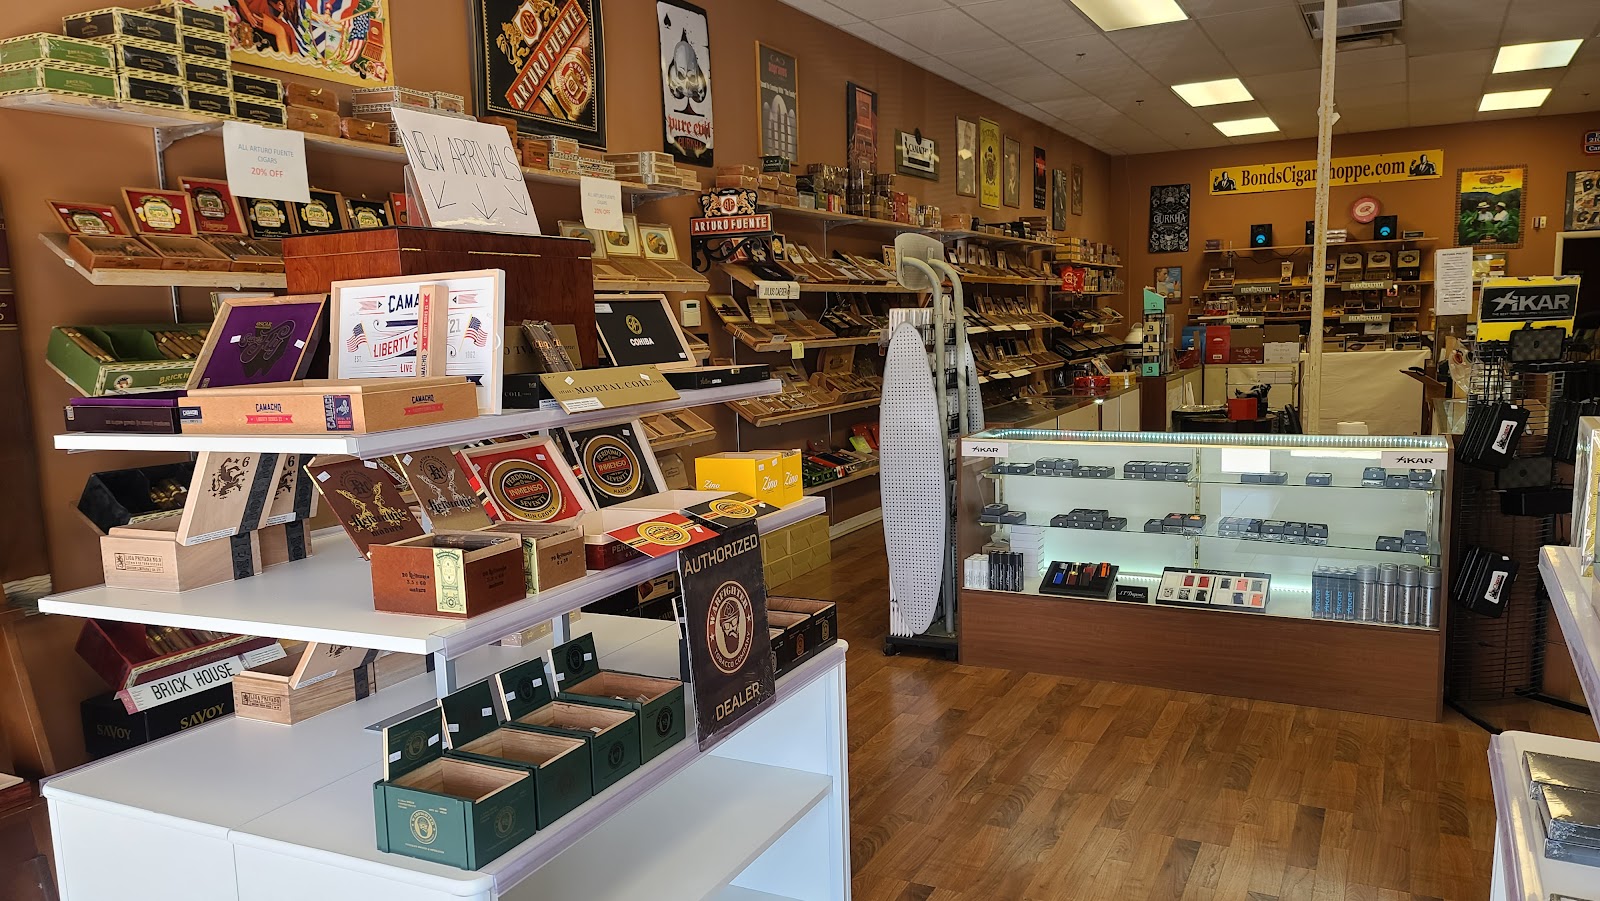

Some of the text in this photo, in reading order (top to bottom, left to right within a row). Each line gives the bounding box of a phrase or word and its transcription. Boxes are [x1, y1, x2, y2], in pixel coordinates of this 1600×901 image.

[512, 5, 581, 108] ARTURO FUENTE
[238, 143, 294, 158] ALL ARTURO FUENTE
[400, 129, 523, 182] NEW ARRIVALS
[257, 155, 278, 165] CIGARS
[251, 167, 284, 178] 20% OFF
[1241, 160, 1405, 187] BondsCigarhoppe.com
[694, 216, 768, 232] ARTURO FUENTE
[1153, 213, 1187, 225] GURKHA
[388, 293, 420, 313] CAMA
[373, 334, 410, 358] LIBERTY
[629, 337, 655, 347] COHIBA
[400, 363, 413, 373] LIVE
[159, 374, 183, 384] BRICK
[574, 382, 623, 395] MORTAL
[624, 379, 652, 389] COIL
[411, 394, 436, 404] CAMACHO
[255, 403, 283, 413] CAMACHO
[242, 456, 250, 467] 6
[703, 480, 721, 489] Zino
[762, 476, 778, 491] Zino
[784, 471, 799, 486] Zino
[508, 483, 544, 497] INMENSO
[520, 495, 547, 507] SEVENTY
[684, 533, 758, 577] AUTHORIZED
[709, 585, 749, 626] WARFIGHTER
[714, 632, 751, 668] TOBACCO COMPANY
[150, 662, 235, 700] BRICK HOUSE
[716, 681, 761, 721] DEALER
[180, 702, 225, 730] SAVOY
[96, 724, 132, 740] SAVOY
